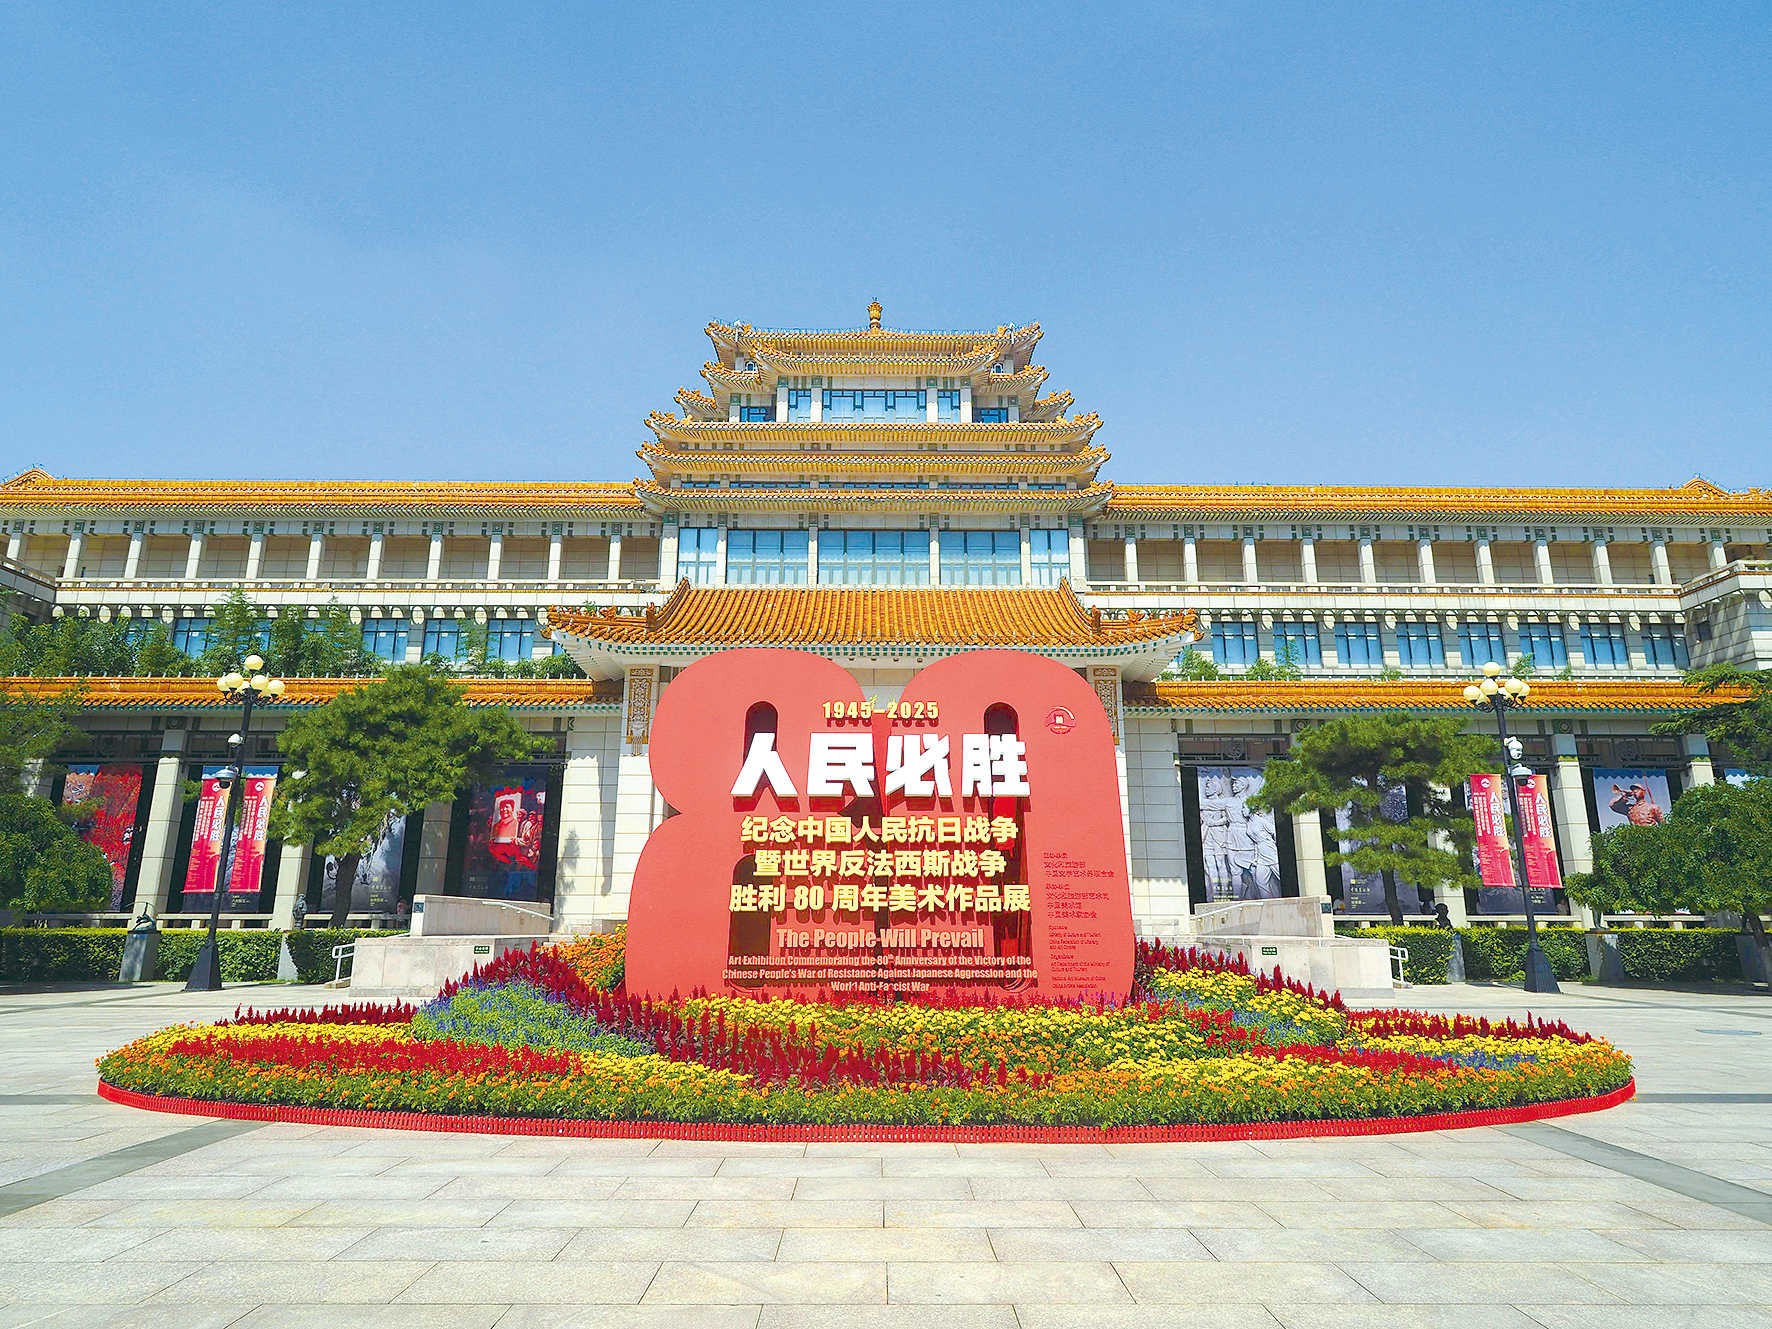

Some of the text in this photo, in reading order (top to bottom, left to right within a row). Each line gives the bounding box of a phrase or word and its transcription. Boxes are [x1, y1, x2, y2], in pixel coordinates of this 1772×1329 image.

[730, 732, 1030, 797] 人民必胜
[740, 816, 1019, 844] 纪念中国人民抗日战争
[752, 850, 1007, 878] 暨世界反法西斯战争
[728, 884, 1031, 913] 胜利 80 周年美术作品展
[776, 928, 984, 949] The People Will Prevail
[728, 955, 742, 966] Art
[742, 955, 786, 966] Exhibition
[787, 955, 860, 966] Commemorating
[861, 955, 875, 966] the
[894, 955, 947, 967] Anniversary
[948, 955, 958, 966] of
[958, 955, 973, 966] the
[974, 955, 1006, 967] Victory
[1006, 955, 1016, 966] of
[1017, 955, 1032, 966] the
[722, 968, 758, 979] Chinese
[798, 968, 816, 979] War
[817, 968, 827, 979] of
[827, 968, 876, 979] Resistance
[877, 968, 911, 979] Against
[911, 968, 954, 979] Japanese
[954, 968, 1004, 979] Aggression
[1005, 968, 1022, 979] and
[1022, 968, 1038, 979] the
[911, 981, 930, 992] War
